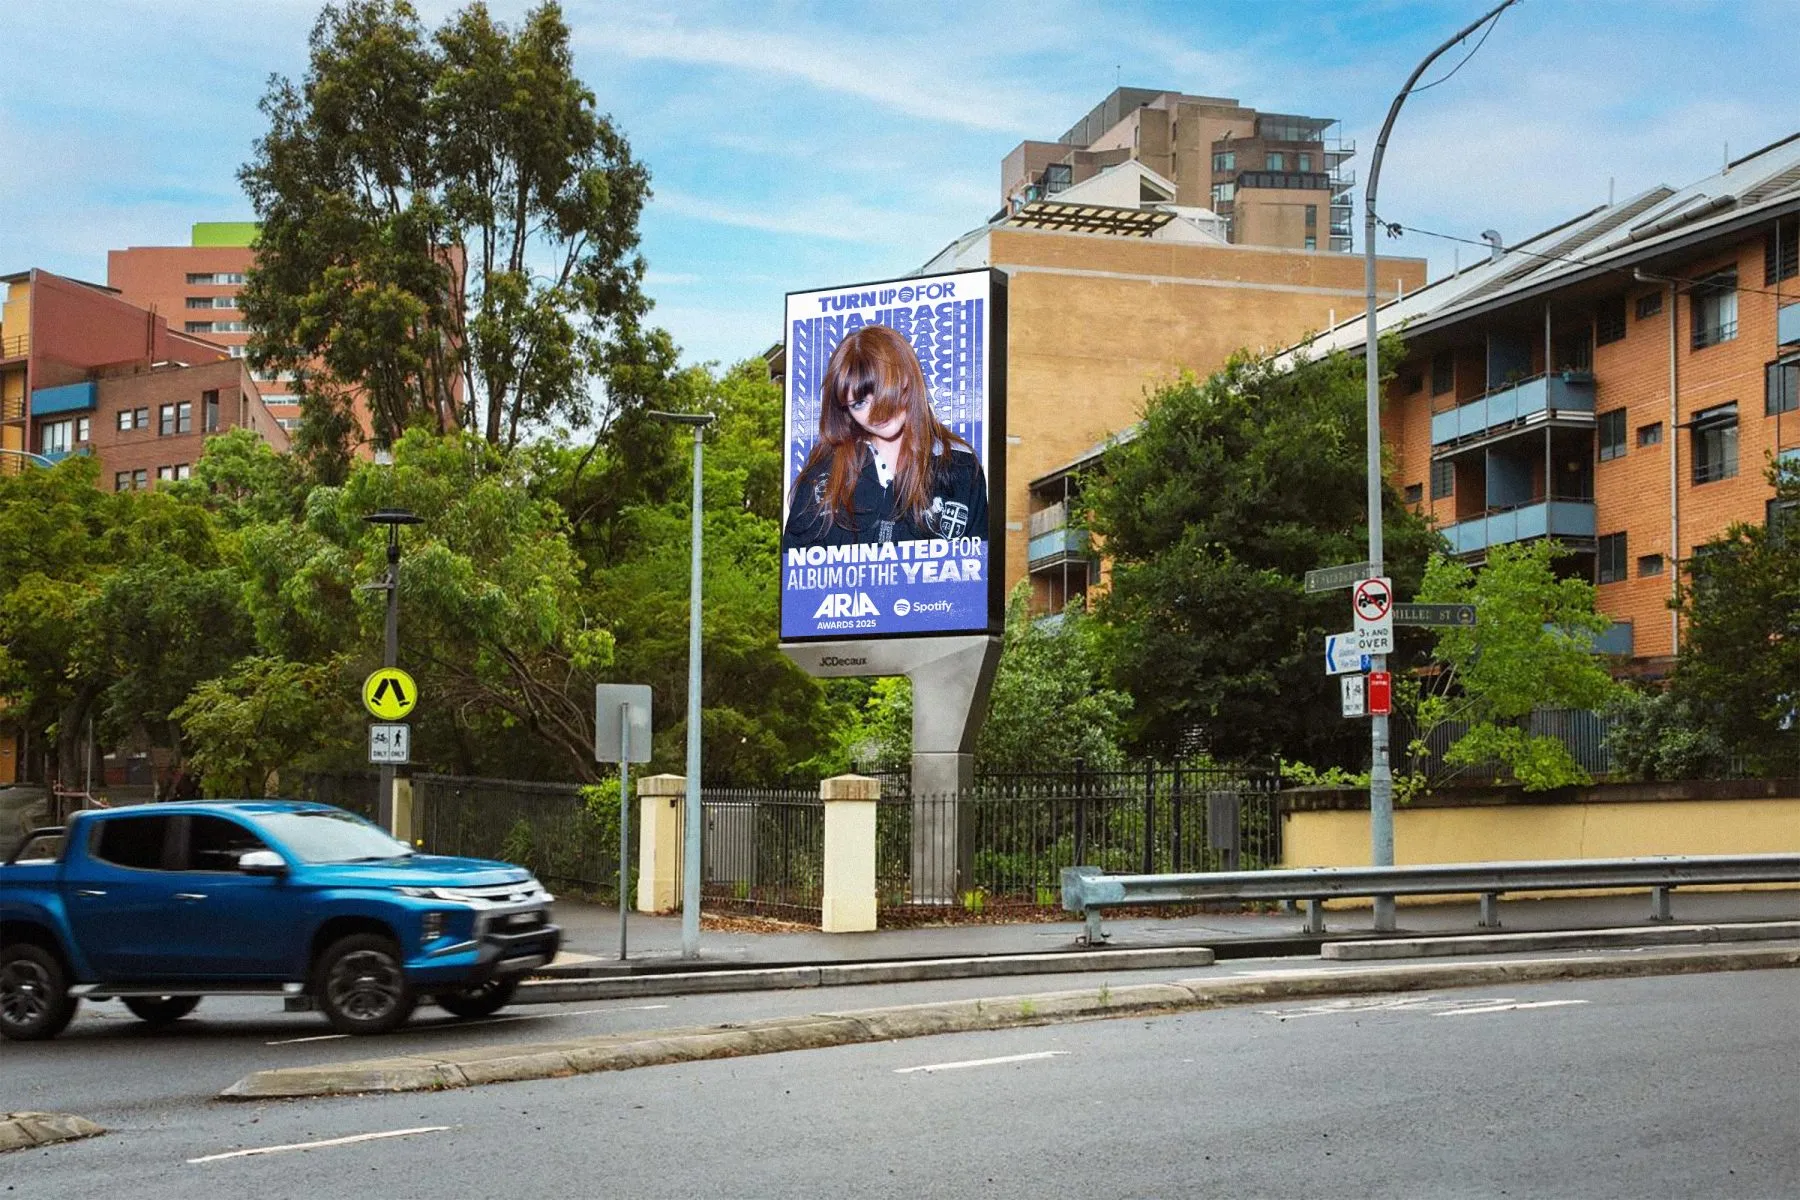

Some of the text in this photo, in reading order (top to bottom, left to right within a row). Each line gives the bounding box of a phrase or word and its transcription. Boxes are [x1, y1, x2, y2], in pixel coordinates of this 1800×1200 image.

[818, 282, 955, 312] TURN UP FOR
[788, 536, 982, 567] NOMINATED FOR
[787, 559, 982, 590] ALBUM OF THE YEAR
[813, 589, 880, 618] ARIA
[913, 601, 952, 613] Spotify
[817, 619, 877, 630] AWARDS 2025
[1372, 628, 1388, 636] AND
[1359, 638, 1388, 649] OVER
[819, 656, 867, 668] JCDecaux
